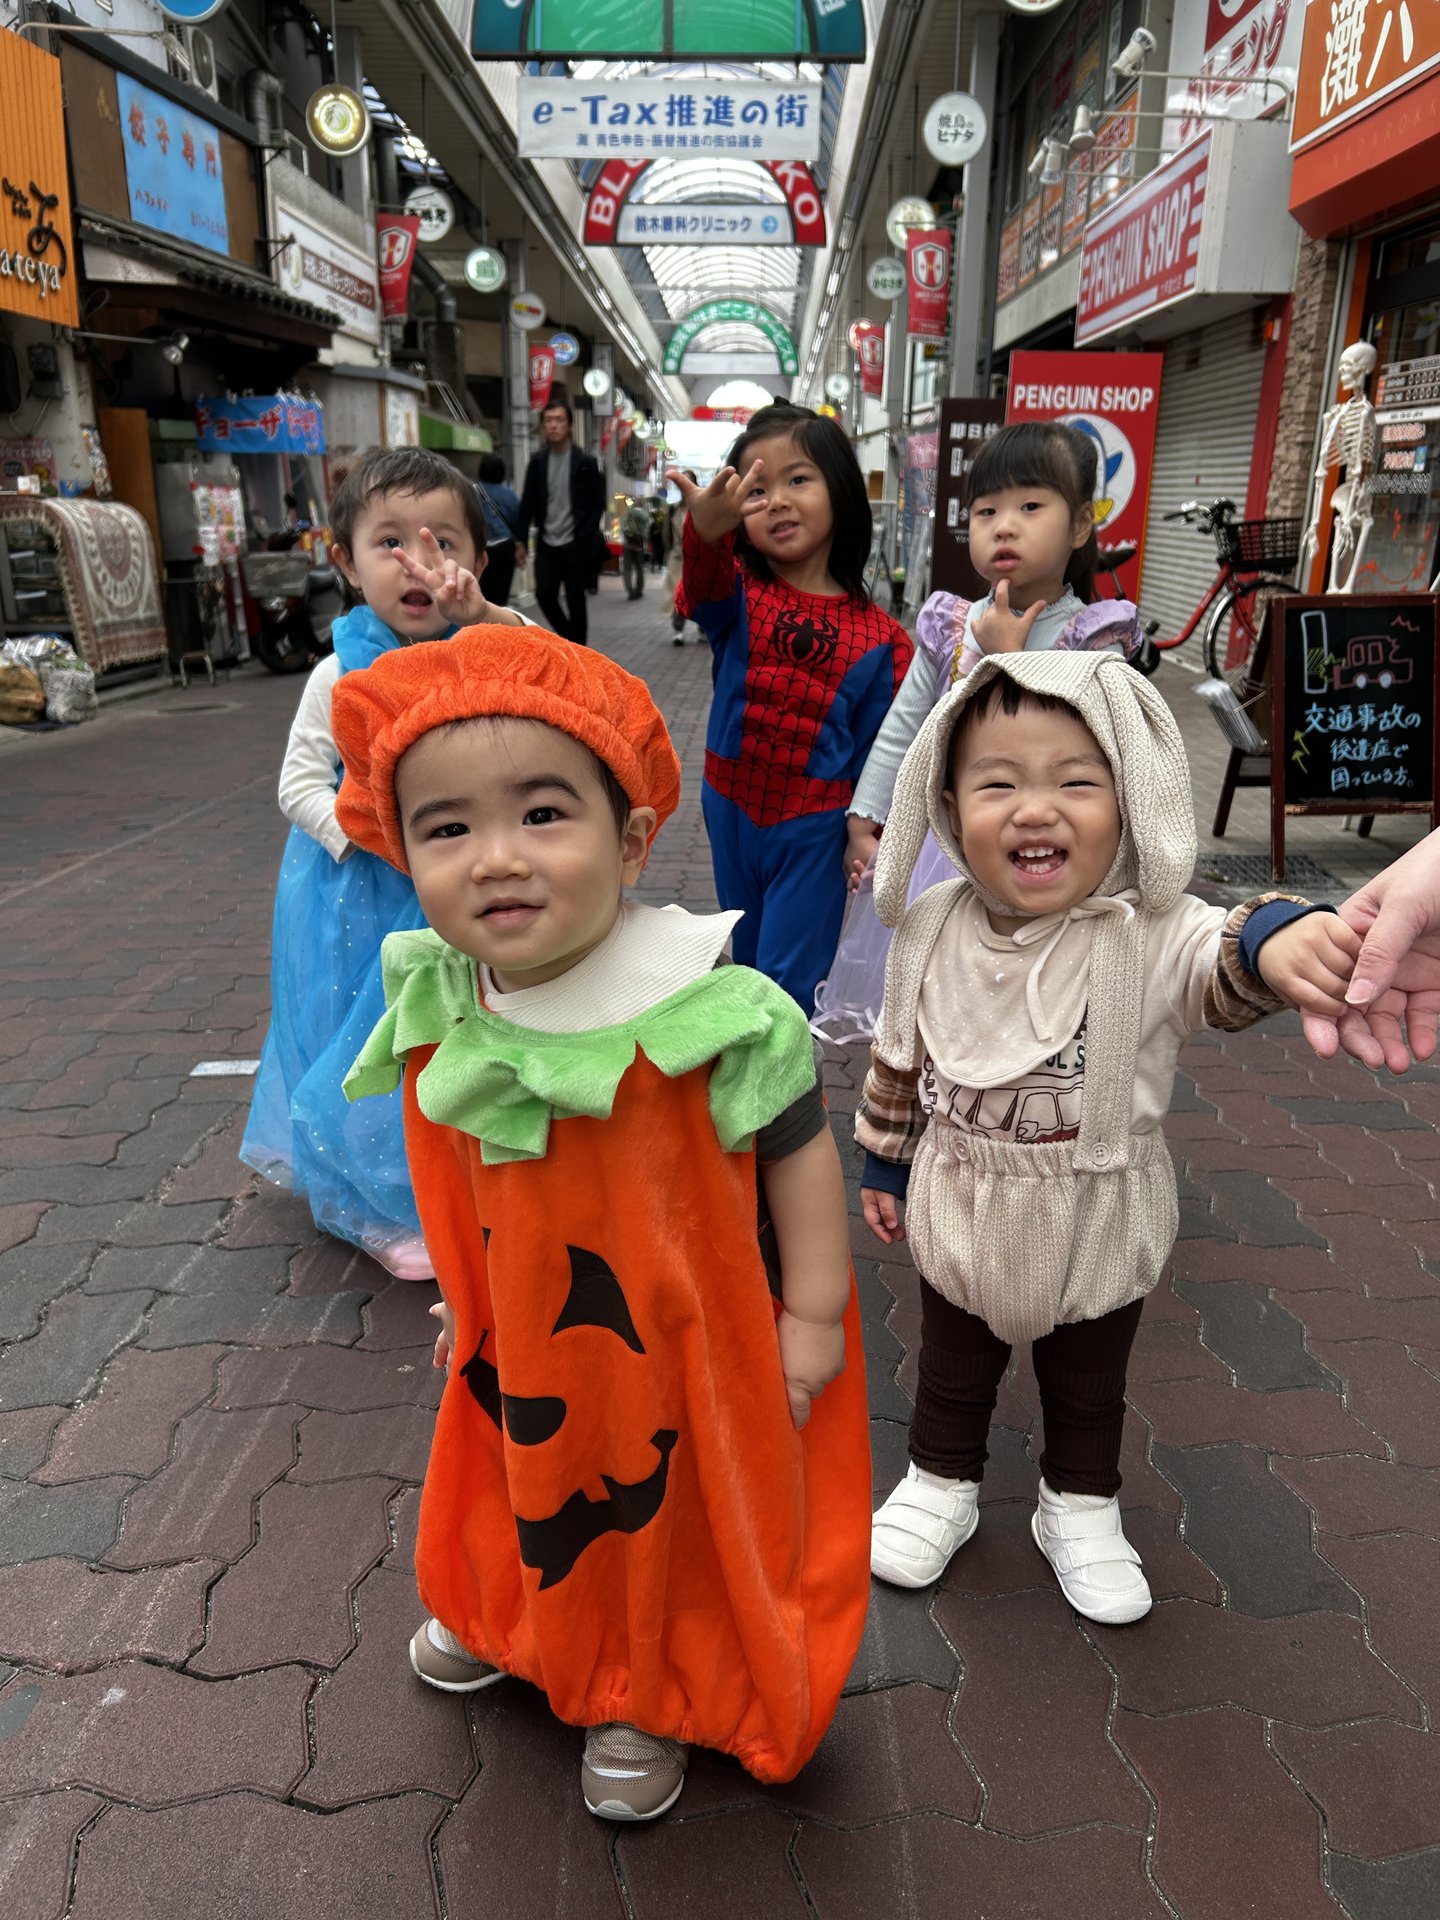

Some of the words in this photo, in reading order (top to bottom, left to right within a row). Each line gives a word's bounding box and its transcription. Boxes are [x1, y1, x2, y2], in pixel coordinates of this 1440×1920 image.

[938, 114, 974, 128] 焼鳥の
[938, 130, 975, 144] ヒナタ
[1087, 213, 1146, 311] PENGUIN
[1144, 181, 1191, 280] SHOP
[1013, 384, 1099, 410] PENGUIN
[1100, 386, 1154, 411] SHOP
[1304, 702, 1421, 733] 交通事故の
[1331, 737, 1409, 761] 後遺症で
